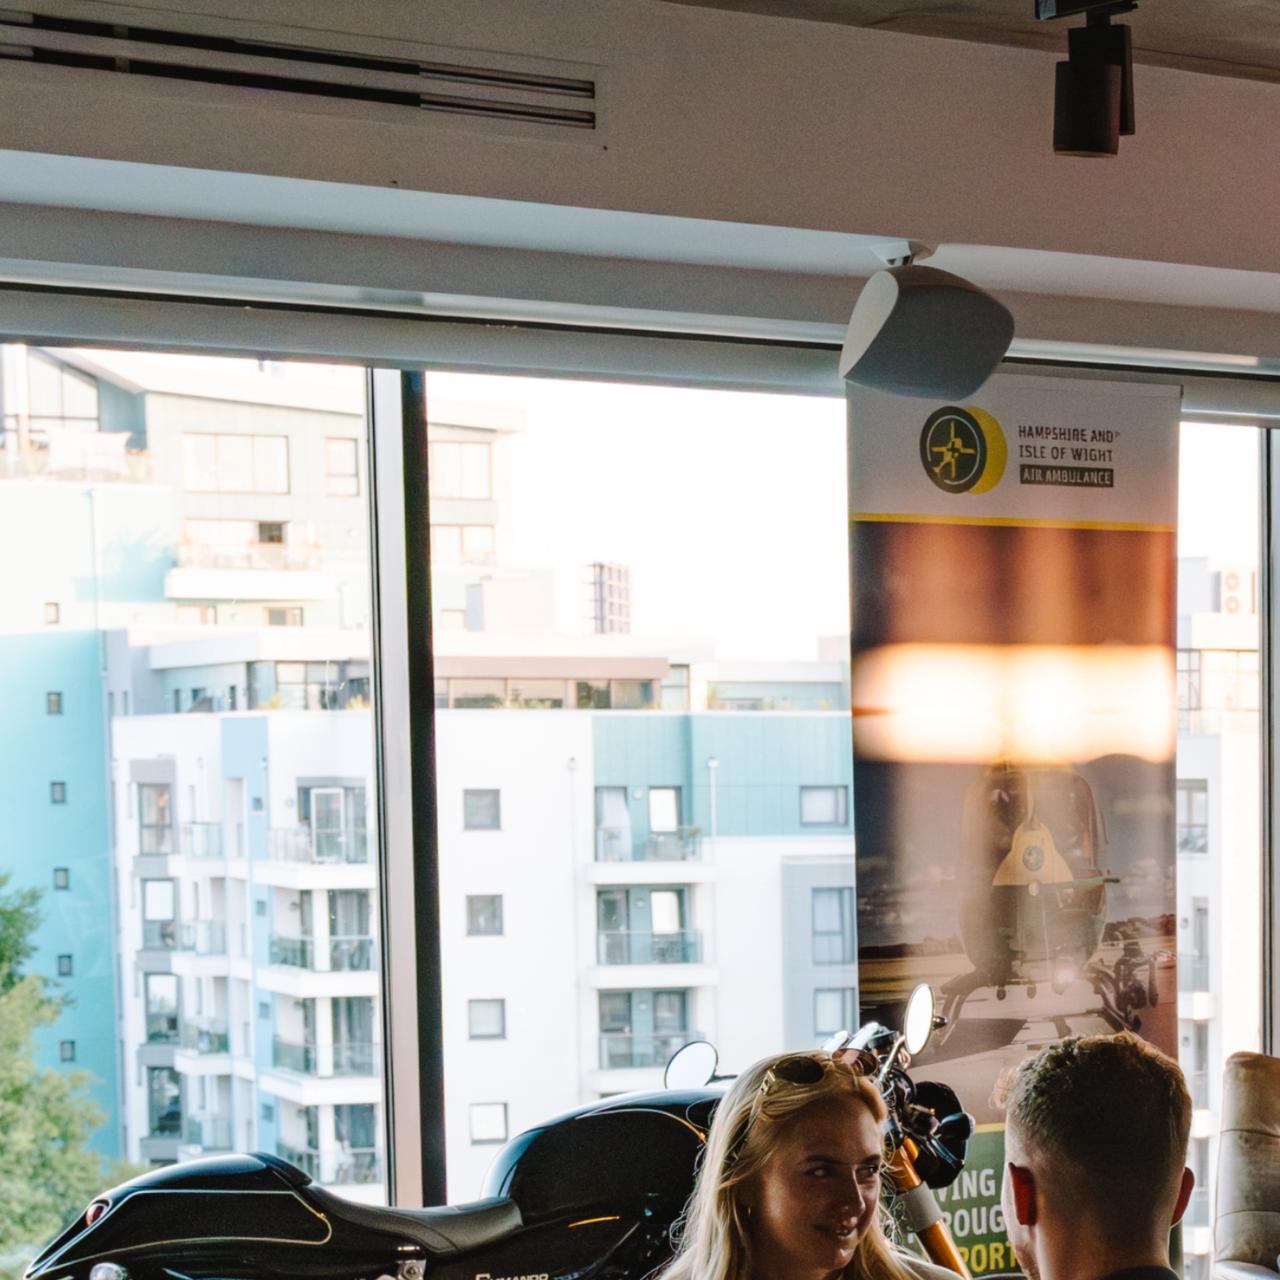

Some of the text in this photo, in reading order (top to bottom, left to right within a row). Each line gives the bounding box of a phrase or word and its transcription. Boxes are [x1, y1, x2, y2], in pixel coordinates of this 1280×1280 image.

[1018, 425, 1114, 443] HAMPSHIRE AND
[1019, 445, 1113, 462] ISLE OF WIGHT
[1023, 467, 1111, 485] AIR AMBULANCE
